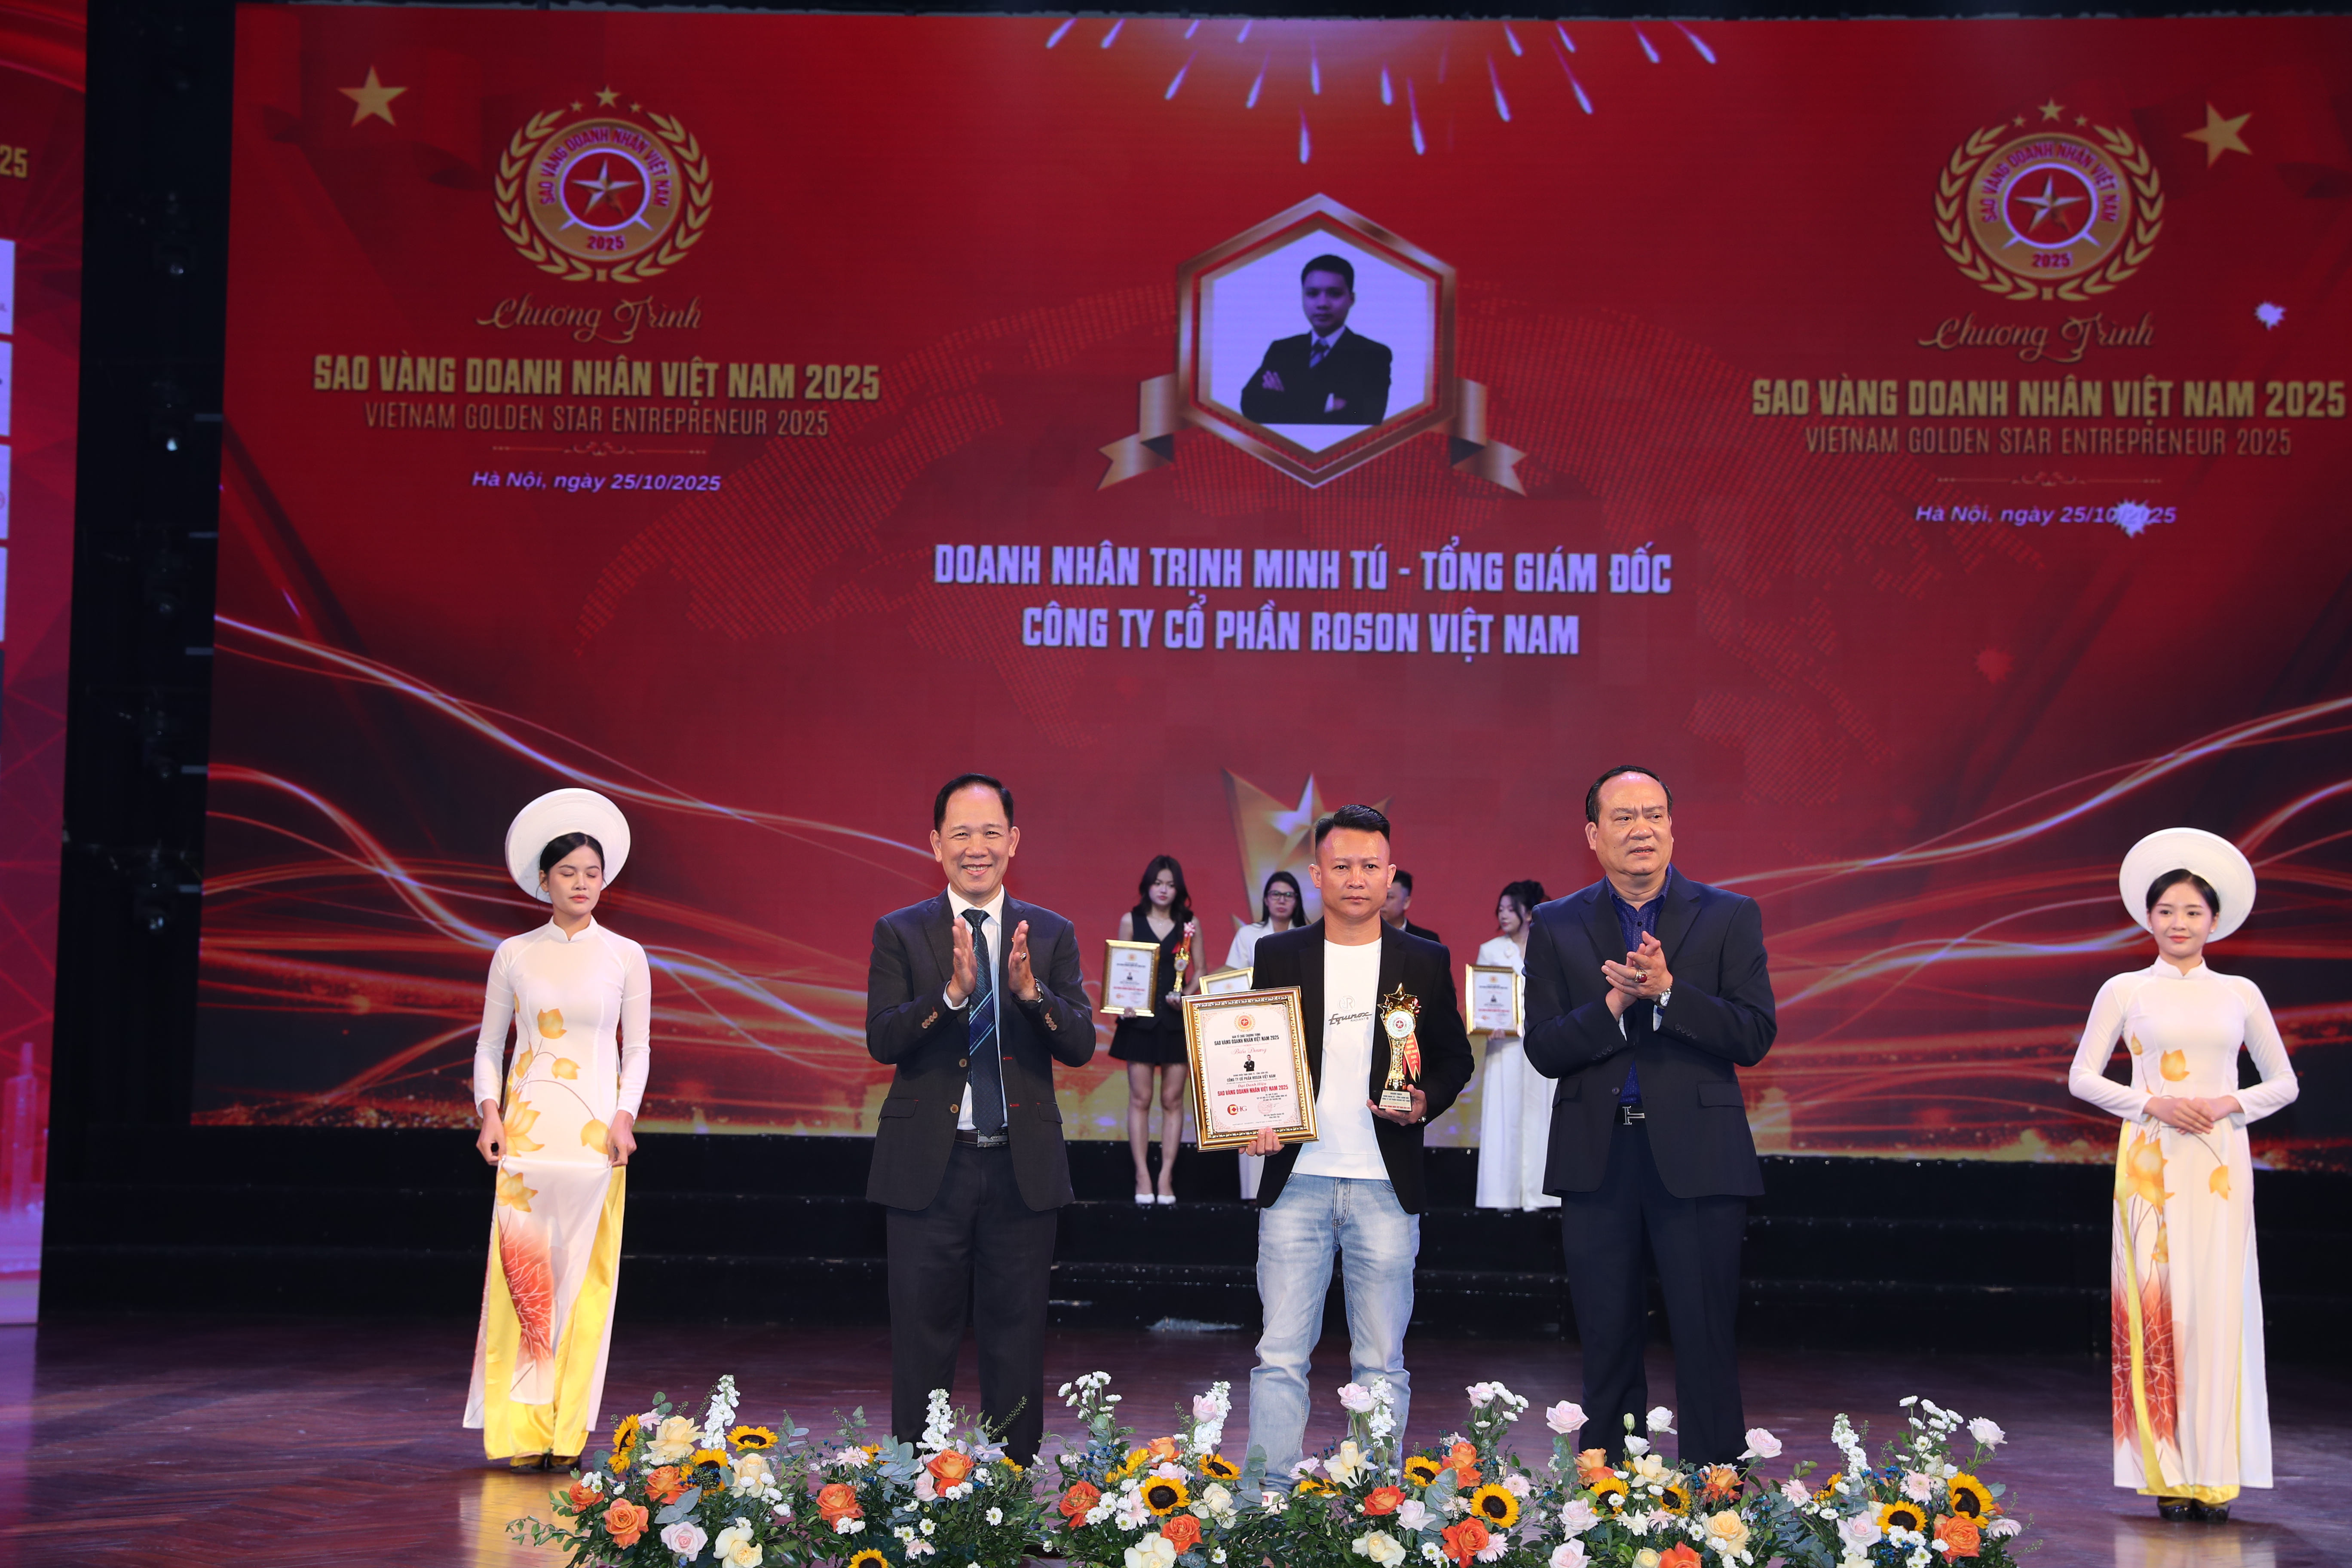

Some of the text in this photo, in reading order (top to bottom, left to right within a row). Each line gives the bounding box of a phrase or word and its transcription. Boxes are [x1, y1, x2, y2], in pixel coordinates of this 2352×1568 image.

[539, 181, 556, 205] SAO
[565, 128, 610, 152] DOANH
[612, 128, 651, 154] NHÂN
[652, 178, 672, 207] NAM
[587, 235, 625, 251] 2025
[2031, 251, 2073, 269] 2025
[476, 291, 702, 344] Chương Trình
[1917, 311, 2155, 363] Chương Trình
[313, 349, 880, 405] SAO VÀNG DOANH NHÂN VIỆT NAM 2025
[364, 401, 829, 436] VIETNAM GOLDEN STAR ENTREPRENEUR 2025
[1752, 372, 2346, 426] SAO VÀNG DOANH NHÂN VIỆT NAM 2025
[1805, 426, 2292, 456] VIETNAM GOLDEN STAR ENTREPRENEUR 2025
[472, 470, 722, 493] Hà Nội, ngày 25/10/2025
[1915, 505, 1945, 522] Hà
[2000, 505, 2056, 527] ngày
[934, 535, 1672, 596] DOANH NHÂN TRỊNH MINH TÚ - TỔNG GIÁM ĐỐC
[1022, 593, 1580, 663] CÔNG TY CỔ PHẦN ROSON VIỆT NAM
[1328, 1012, 1372, 1026] Equinox
